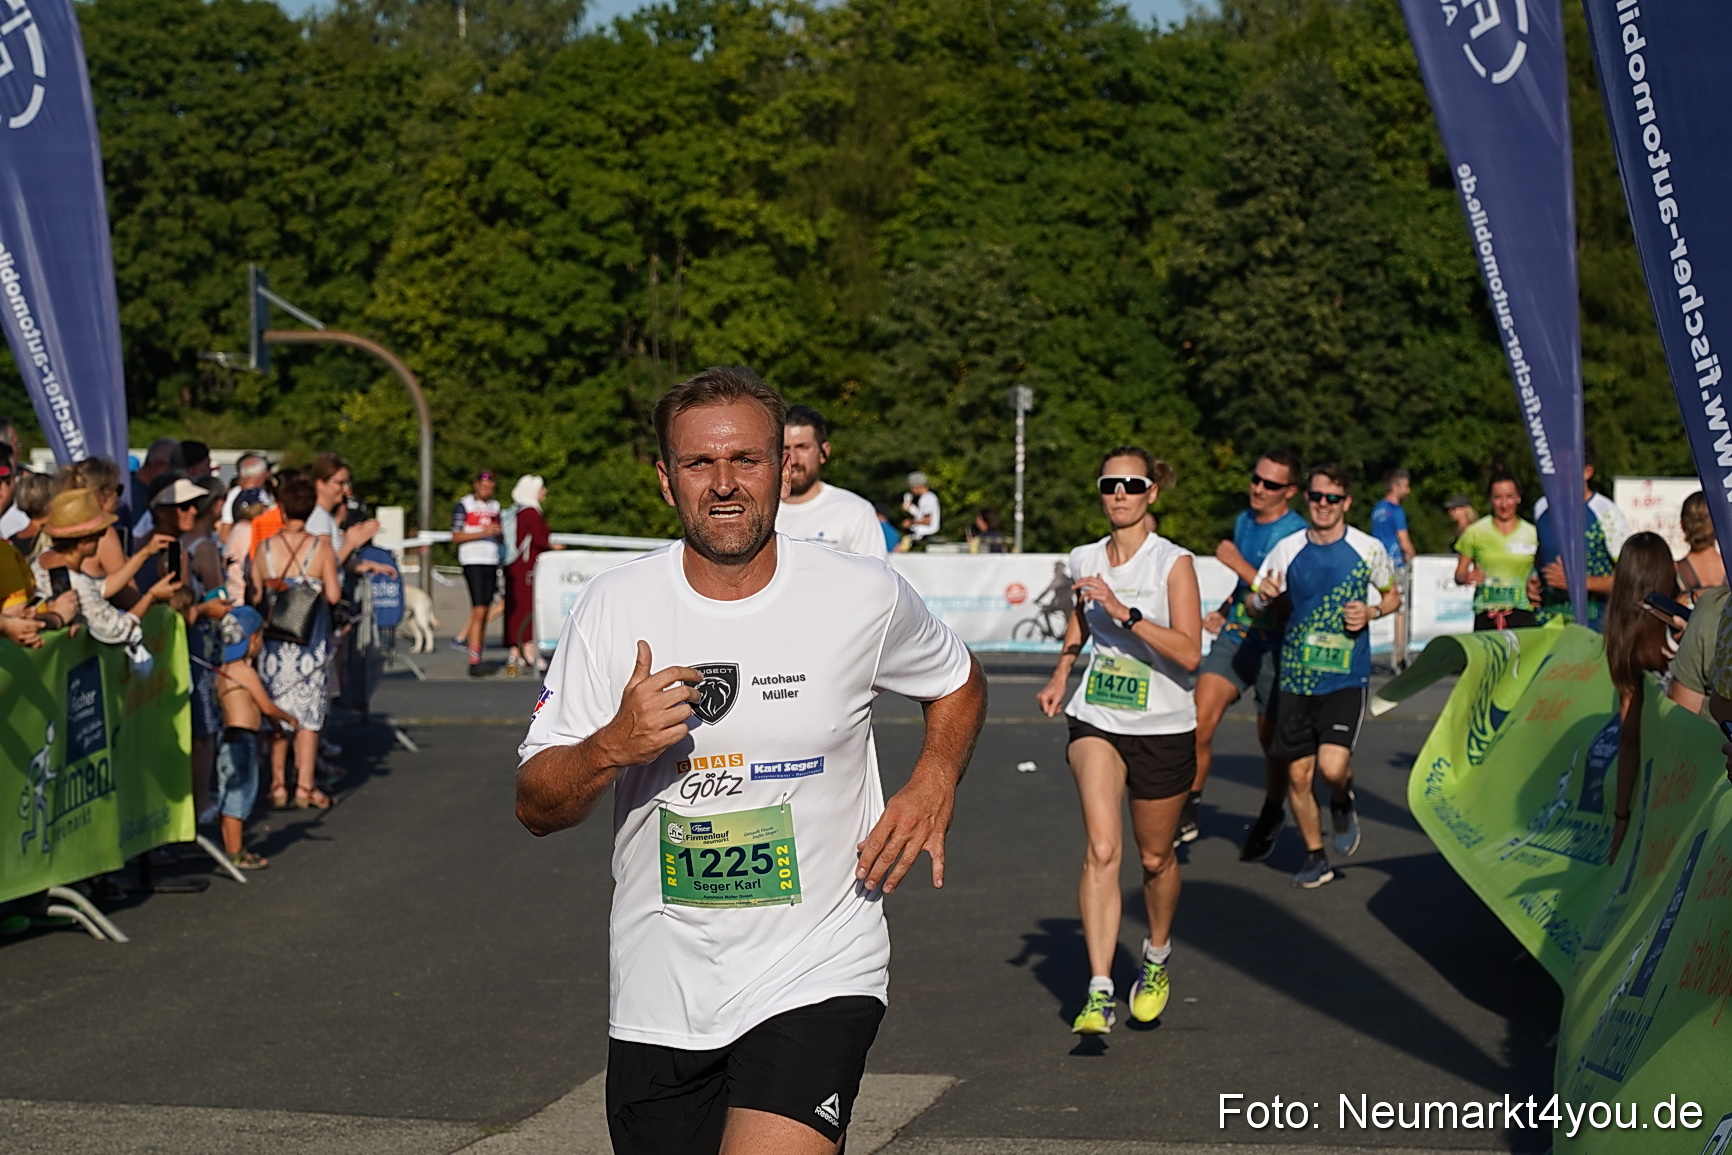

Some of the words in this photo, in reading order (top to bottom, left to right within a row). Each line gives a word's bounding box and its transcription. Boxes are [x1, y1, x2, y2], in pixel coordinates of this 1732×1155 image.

[751, 673, 807, 687] Autohaus
[1096, 673, 1138, 694] 1470
[762, 688, 799, 701] Müller
[679, 754, 742, 773] GLAS
[754, 764, 782, 775] Karl
[783, 760, 819, 773] Seger
[680, 769, 744, 806] Götz
[685, 830, 730, 842] Firmenlauf
[702, 837, 730, 845] neumarkt
[677, 842, 774, 878] 1225
[775, 844, 793, 891] 2022
[665, 852, 678, 887] RUN
[693, 880, 730, 894] Seger
[734, 878, 762, 891] Karl
